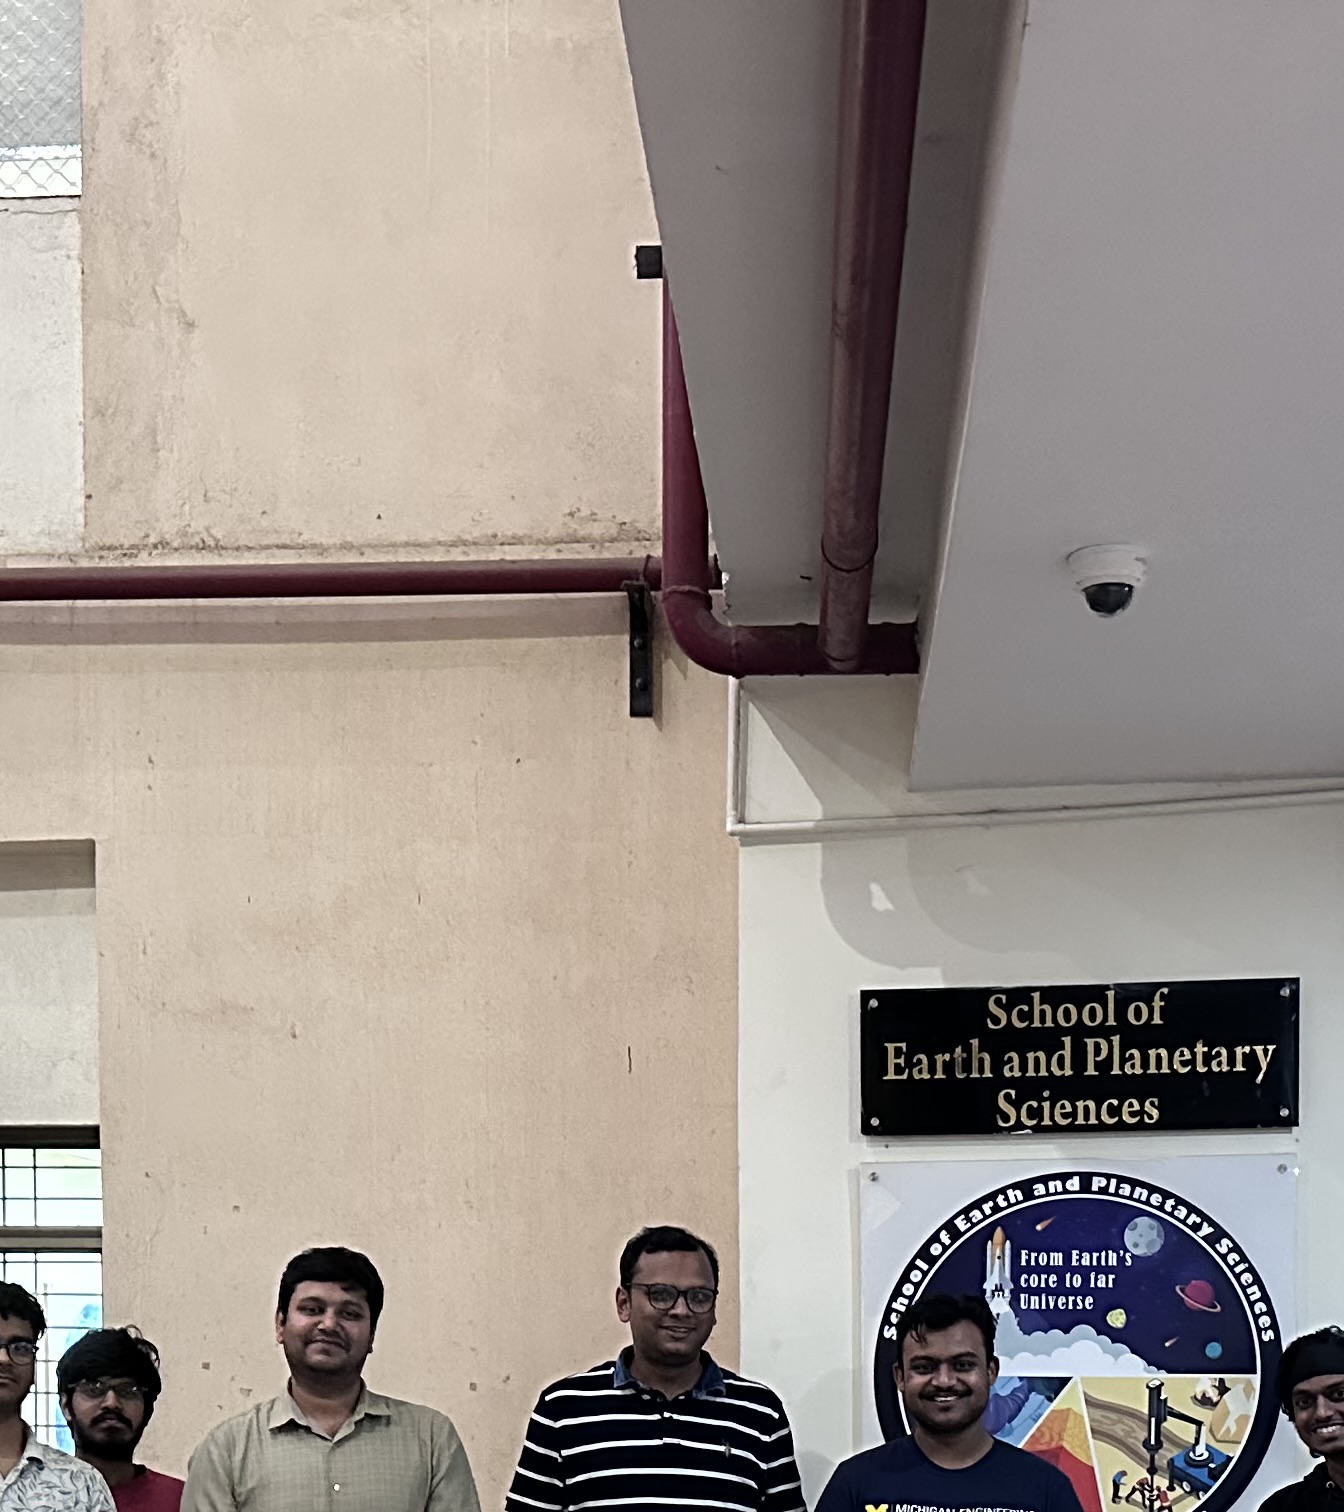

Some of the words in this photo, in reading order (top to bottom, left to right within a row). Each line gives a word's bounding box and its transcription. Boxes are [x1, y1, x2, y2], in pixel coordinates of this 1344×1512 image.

[986, 989, 1117, 1030] School
[1127, 987, 1169, 1026] of
[882, 1038, 994, 1081] Earth
[1003, 1036, 1073, 1077] and
[1084, 1034, 1277, 1084] Planetary
[996, 1089, 1160, 1127] Sciences
[883, 1258, 929, 1341] School
[930, 1230, 951, 1256] of
[954, 1188, 1024, 1232] Earth
[1032, 1176, 1080, 1197] and
[1091, 1176, 1215, 1238] Planetary
[1215, 1237, 1275, 1342] Sciences
[1020, 1249, 1063, 1267] From
[1071, 1249, 1133, 1267] Earth's
[1020, 1273, 1058, 1288] core
[1065, 1271, 1082, 1288] to
[1090, 1271, 1116, 1288] far
[1020, 1292, 1094, 1310] Universe
